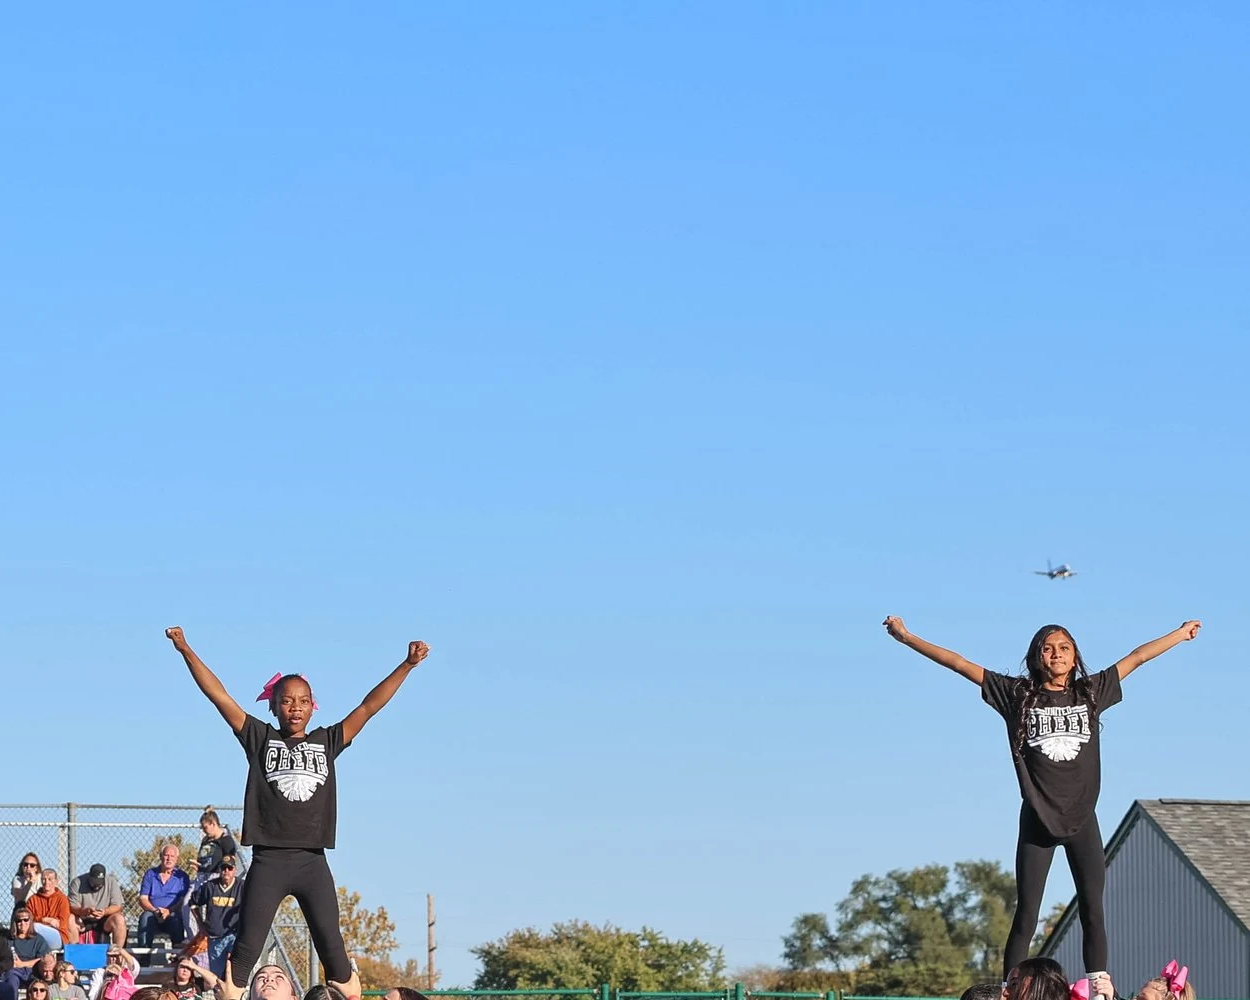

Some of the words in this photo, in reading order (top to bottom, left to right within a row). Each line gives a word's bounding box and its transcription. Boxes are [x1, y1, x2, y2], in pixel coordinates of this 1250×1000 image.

[1044, 706, 1071, 716] UNITED
[1027, 712, 1091, 739] CHEER
[265, 748, 329, 778] CHEER
